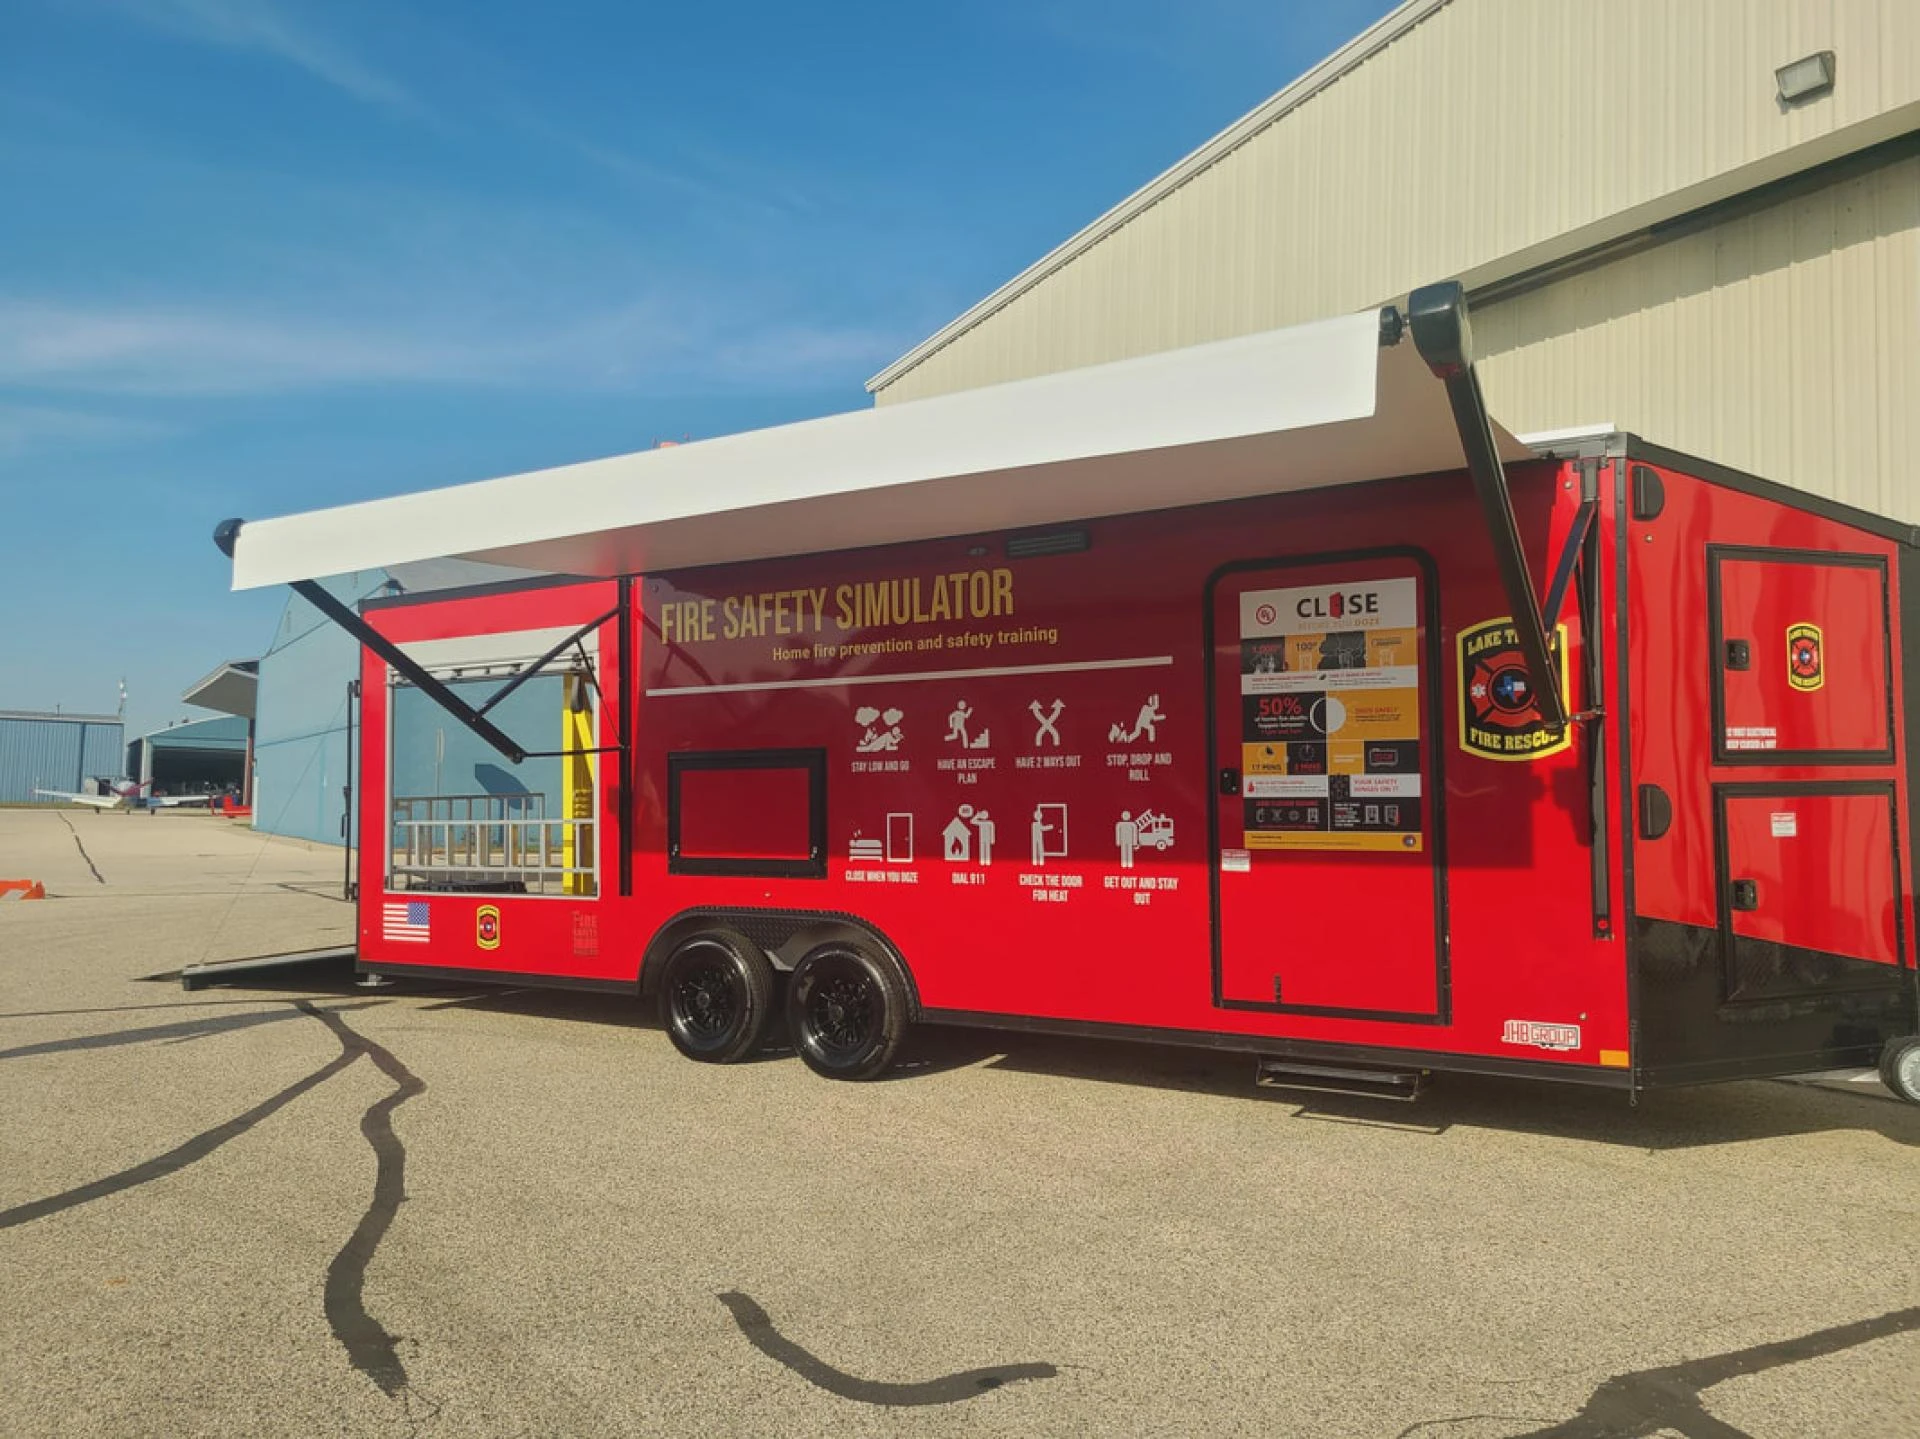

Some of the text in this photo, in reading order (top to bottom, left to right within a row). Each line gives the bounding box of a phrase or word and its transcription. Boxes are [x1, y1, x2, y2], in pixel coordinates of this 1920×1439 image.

[660, 568, 1015, 645] FIRE SAFETY SIMULATOR
[773, 626, 1058, 662] Home fire prevention and safety training
[1467, 630, 1502, 656] LAKE
[1258, 696, 1302, 716] 50%
[1469, 726, 1502, 747] FIRE
[851, 760, 910, 772] STAY LOW AND GO
[937, 757, 996, 770] HAVE AN ESCAPE
[1015, 755, 1081, 768] HAVE 2 WAYS OUT
[1106, 752, 1172, 767] STOP, DROP AND
[957, 772, 977, 784] PLAN
[1128, 769, 1150, 781] ROLL
[845, 870, 918, 884] CLOSE WHEN YOU DOZE
[952, 873, 985, 885] DIAL 911
[1019, 874, 1083, 887] CHECK THE DOOR
[1104, 876, 1179, 890] GET OUT AND STAY
[1032, 889, 1068, 902] FOR HEAT
[1133, 892, 1150, 905] OUT
